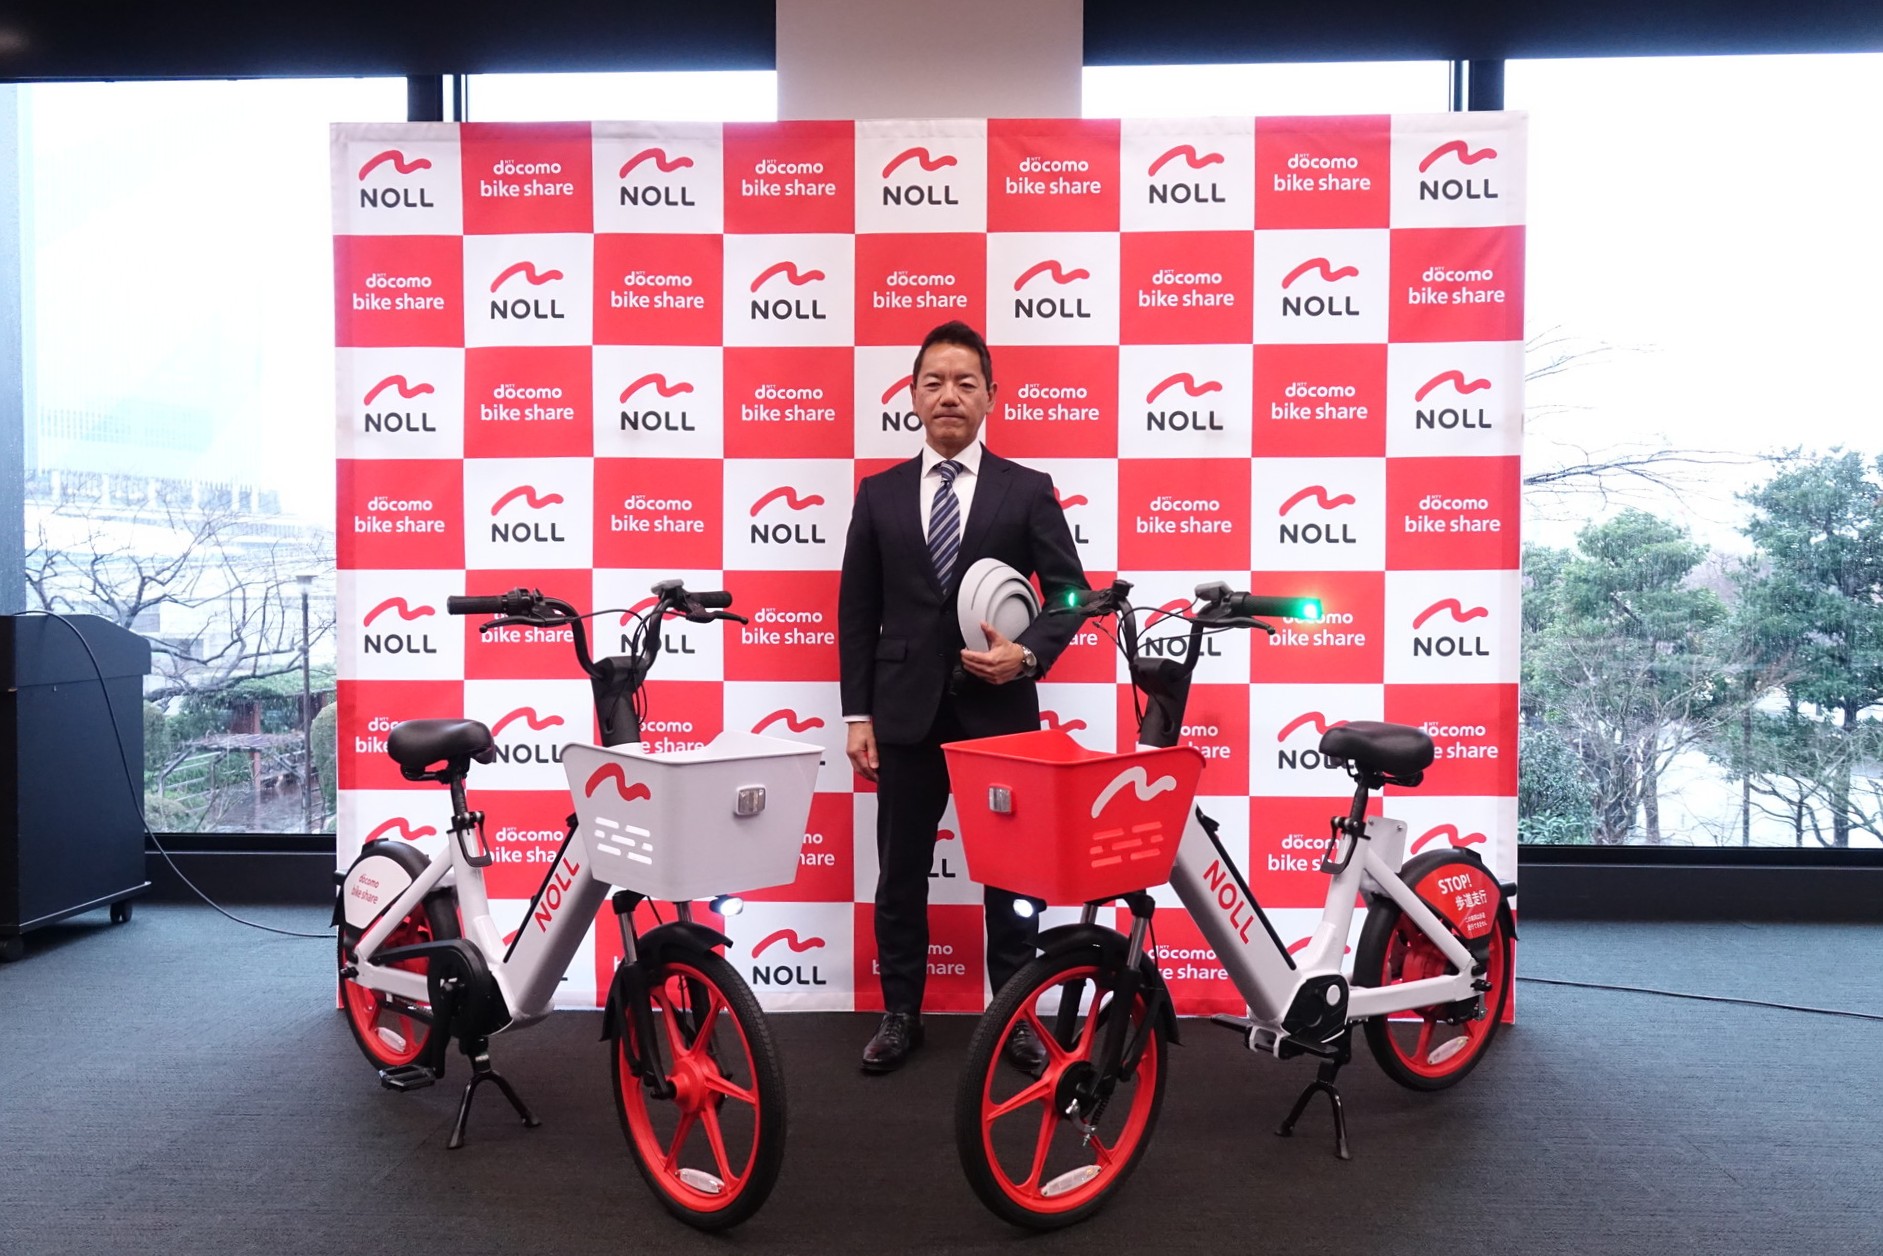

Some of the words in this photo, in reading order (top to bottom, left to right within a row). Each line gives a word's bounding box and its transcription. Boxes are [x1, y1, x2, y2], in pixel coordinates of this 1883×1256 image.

[480, 179, 521, 197] bike
[523, 178, 574, 197] share
[741, 178, 782, 197] bike
[784, 178, 836, 196] share
[1005, 176, 1046, 195] bike
[1049, 176, 1102, 195] share
[1273, 173, 1315, 192] bike
[1318, 172, 1372, 191] share
[1420, 178, 1498, 200] NOLL
[360, 187, 434, 208] NOLL
[620, 185, 695, 207] NOLL
[883, 185, 959, 206] NOLL
[1149, 183, 1226, 204] NOLL
[352, 292, 392, 311] bike
[394, 292, 445, 311] share
[610, 290, 651, 309] bike
[653, 290, 705, 309] share
[873, 291, 913, 309] bike
[916, 290, 968, 308] share
[1138, 289, 1179, 308] bike
[1182, 288, 1235, 307] share
[1408, 286, 1449, 305] bike
[1451, 286, 1506, 305] share
[490, 299, 565, 320] NOLL
[751, 299, 827, 320] NOLL
[1014, 298, 1091, 319] NOLL
[1282, 296, 1360, 317] NOLL
[480, 403, 521, 422] bike
[524, 403, 575, 421] share
[620, 410, 695, 431] NOLL
[741, 403, 781, 422] bike
[784, 404, 836, 422] share
[1004, 403, 1045, 421] bike
[1047, 403, 1100, 421] share
[1147, 410, 1224, 431] NOLL
[1271, 401, 1312, 420] bike
[1315, 401, 1369, 420] share
[1416, 408, 1492, 429] NOLL
[365, 412, 436, 433] NOLL
[882, 411, 925, 432] NO
[354, 515, 393, 533] bike
[395, 515, 446, 533] share
[491, 522, 565, 543] NOLL
[610, 514, 651, 532] bike
[653, 514, 705, 533] share
[751, 523, 826, 544] NOLL
[1136, 515, 1177, 534] bike
[1179, 515, 1233, 534] share
[1280, 523, 1357, 544] NOLL
[1404, 514, 1447, 533] bike
[1449, 514, 1502, 533] share
[364, 634, 437, 654] NOLL
[481, 626, 522, 644] bike
[524, 626, 574, 644] share
[621, 633, 695, 654] NLL
[741, 627, 781, 645] bike
[784, 627, 835, 645] share
[1069, 633, 1098, 646] are
[1268, 629, 1310, 646] bike
[1312, 628, 1366, 646] share
[1145, 636, 1222, 657] NOL
[1413, 636, 1490, 657] NOLL
[1446, 741, 1499, 759] share
[526, 846, 558, 863] sha
[1267, 853, 1308, 871] bike
[1437, 873, 1473, 895] STOP!
[534, 857, 580, 933] NOLL
[1202, 858, 1255, 945] NOLL
[752, 965, 827, 986] NOLL
[1177, 963, 1229, 980] share
